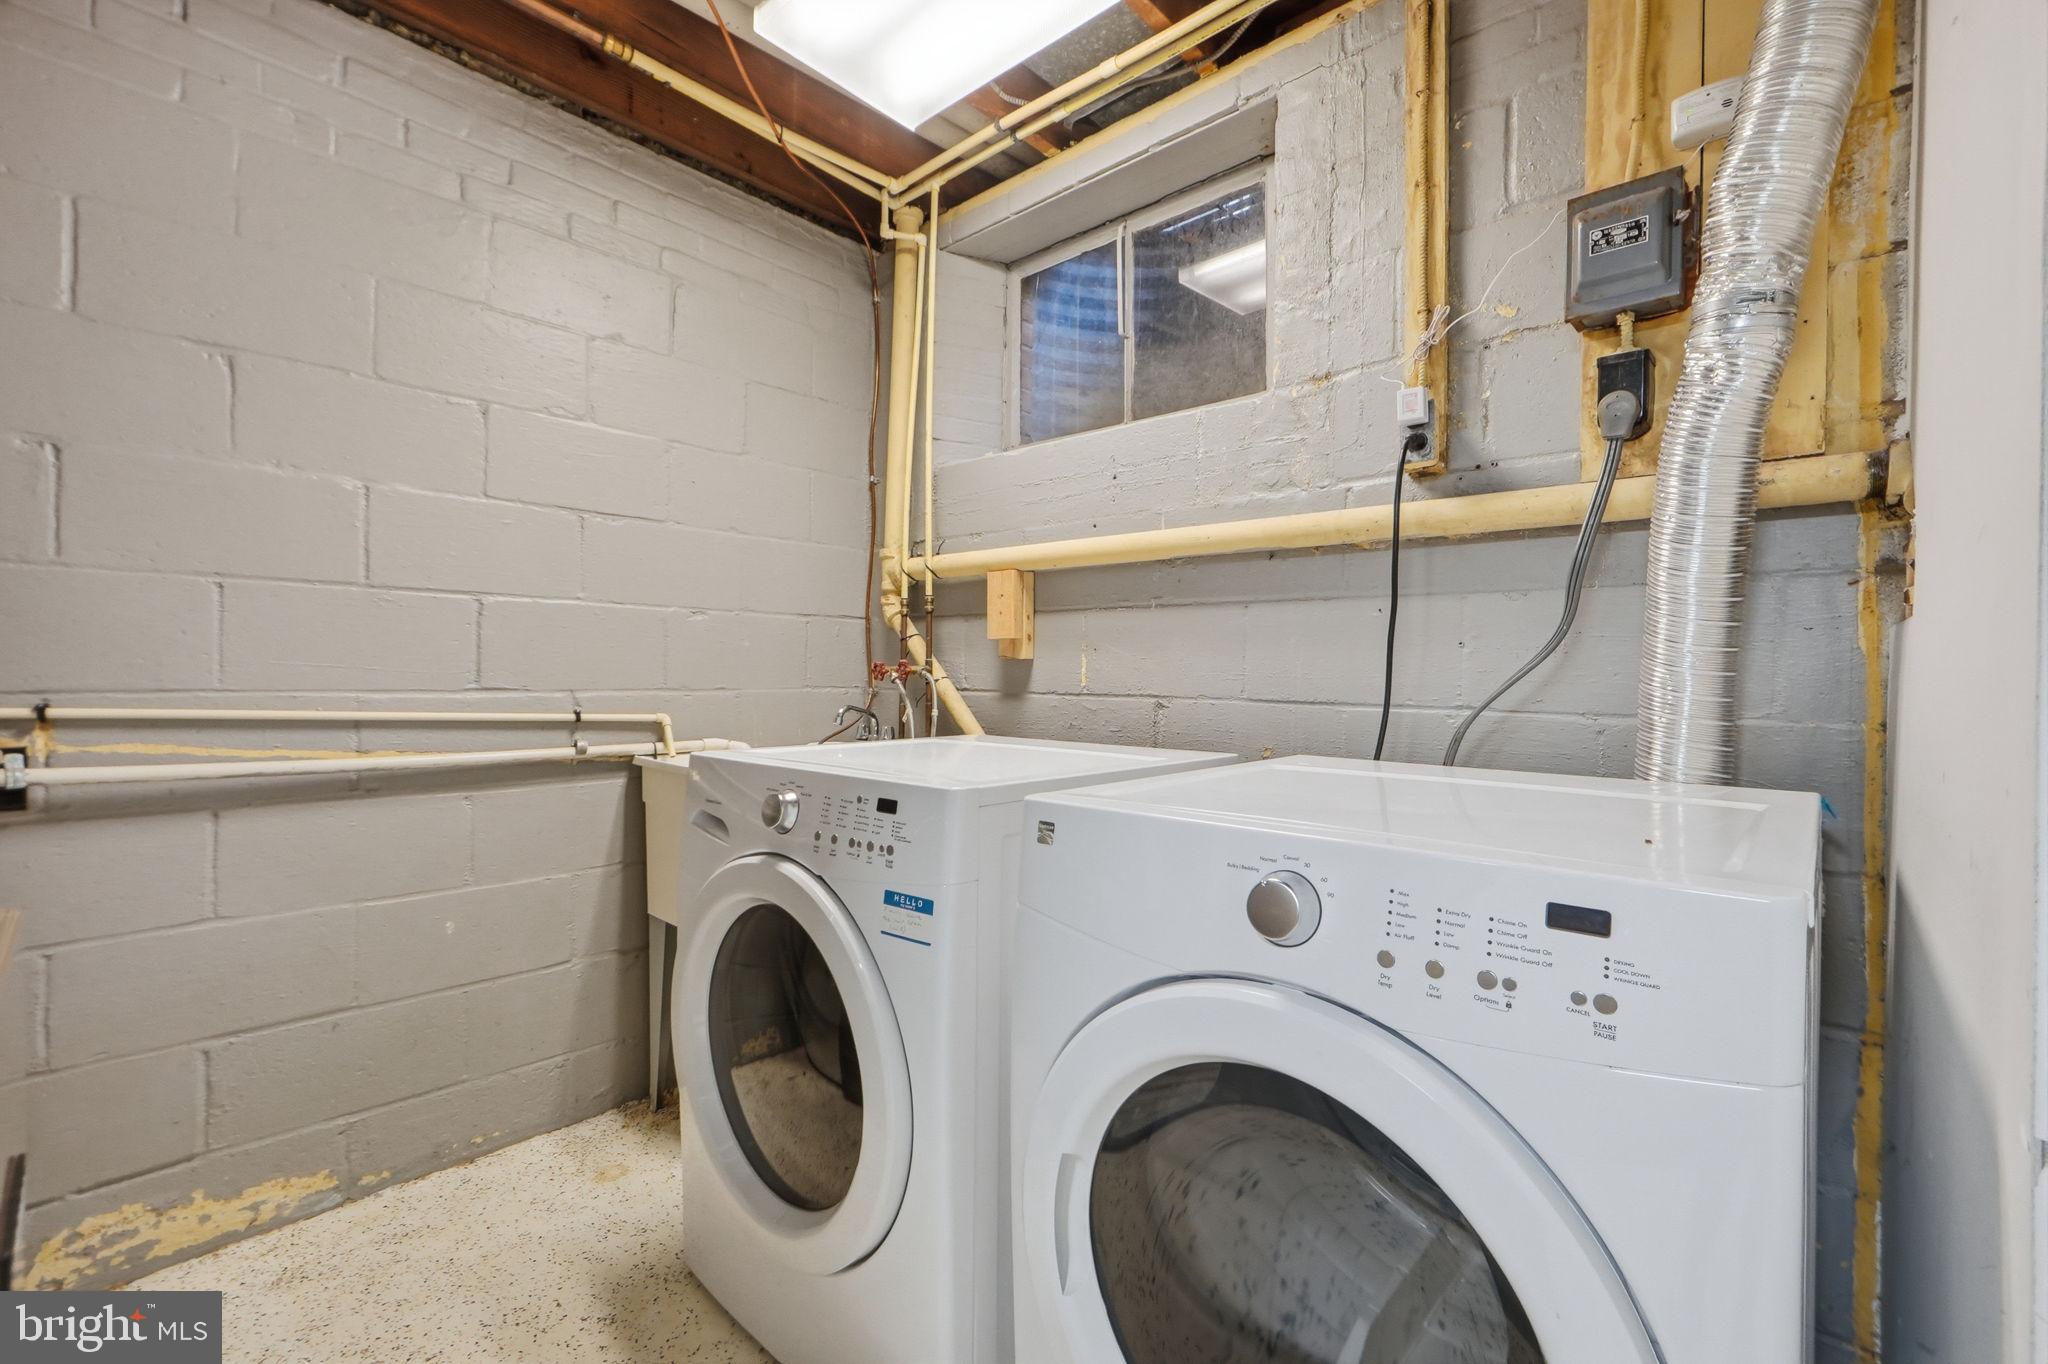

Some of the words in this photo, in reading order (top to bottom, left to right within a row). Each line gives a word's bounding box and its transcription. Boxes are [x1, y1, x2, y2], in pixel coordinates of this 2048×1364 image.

[894, 894, 923, 908] HELLO
[1444, 920, 1466, 928] Normal
[1496, 929, 1515, 938] Chime
[1496, 941, 1519, 950] Wrinkle
[1520, 945, 1540, 954] Guard
[1495, 952, 1518, 961] Wrinkle
[1520, 957, 1540, 966] Guard
[1380, 973, 1391, 981] Dry
[1428, 984, 1440, 992] Dry
[1473, 994, 1499, 1006] Options
[1566, 1006, 1591, 1017] CANCEL
[1592, 1021, 1617, 1032] START
[1594, 1030, 1616, 1042] PAUSE
